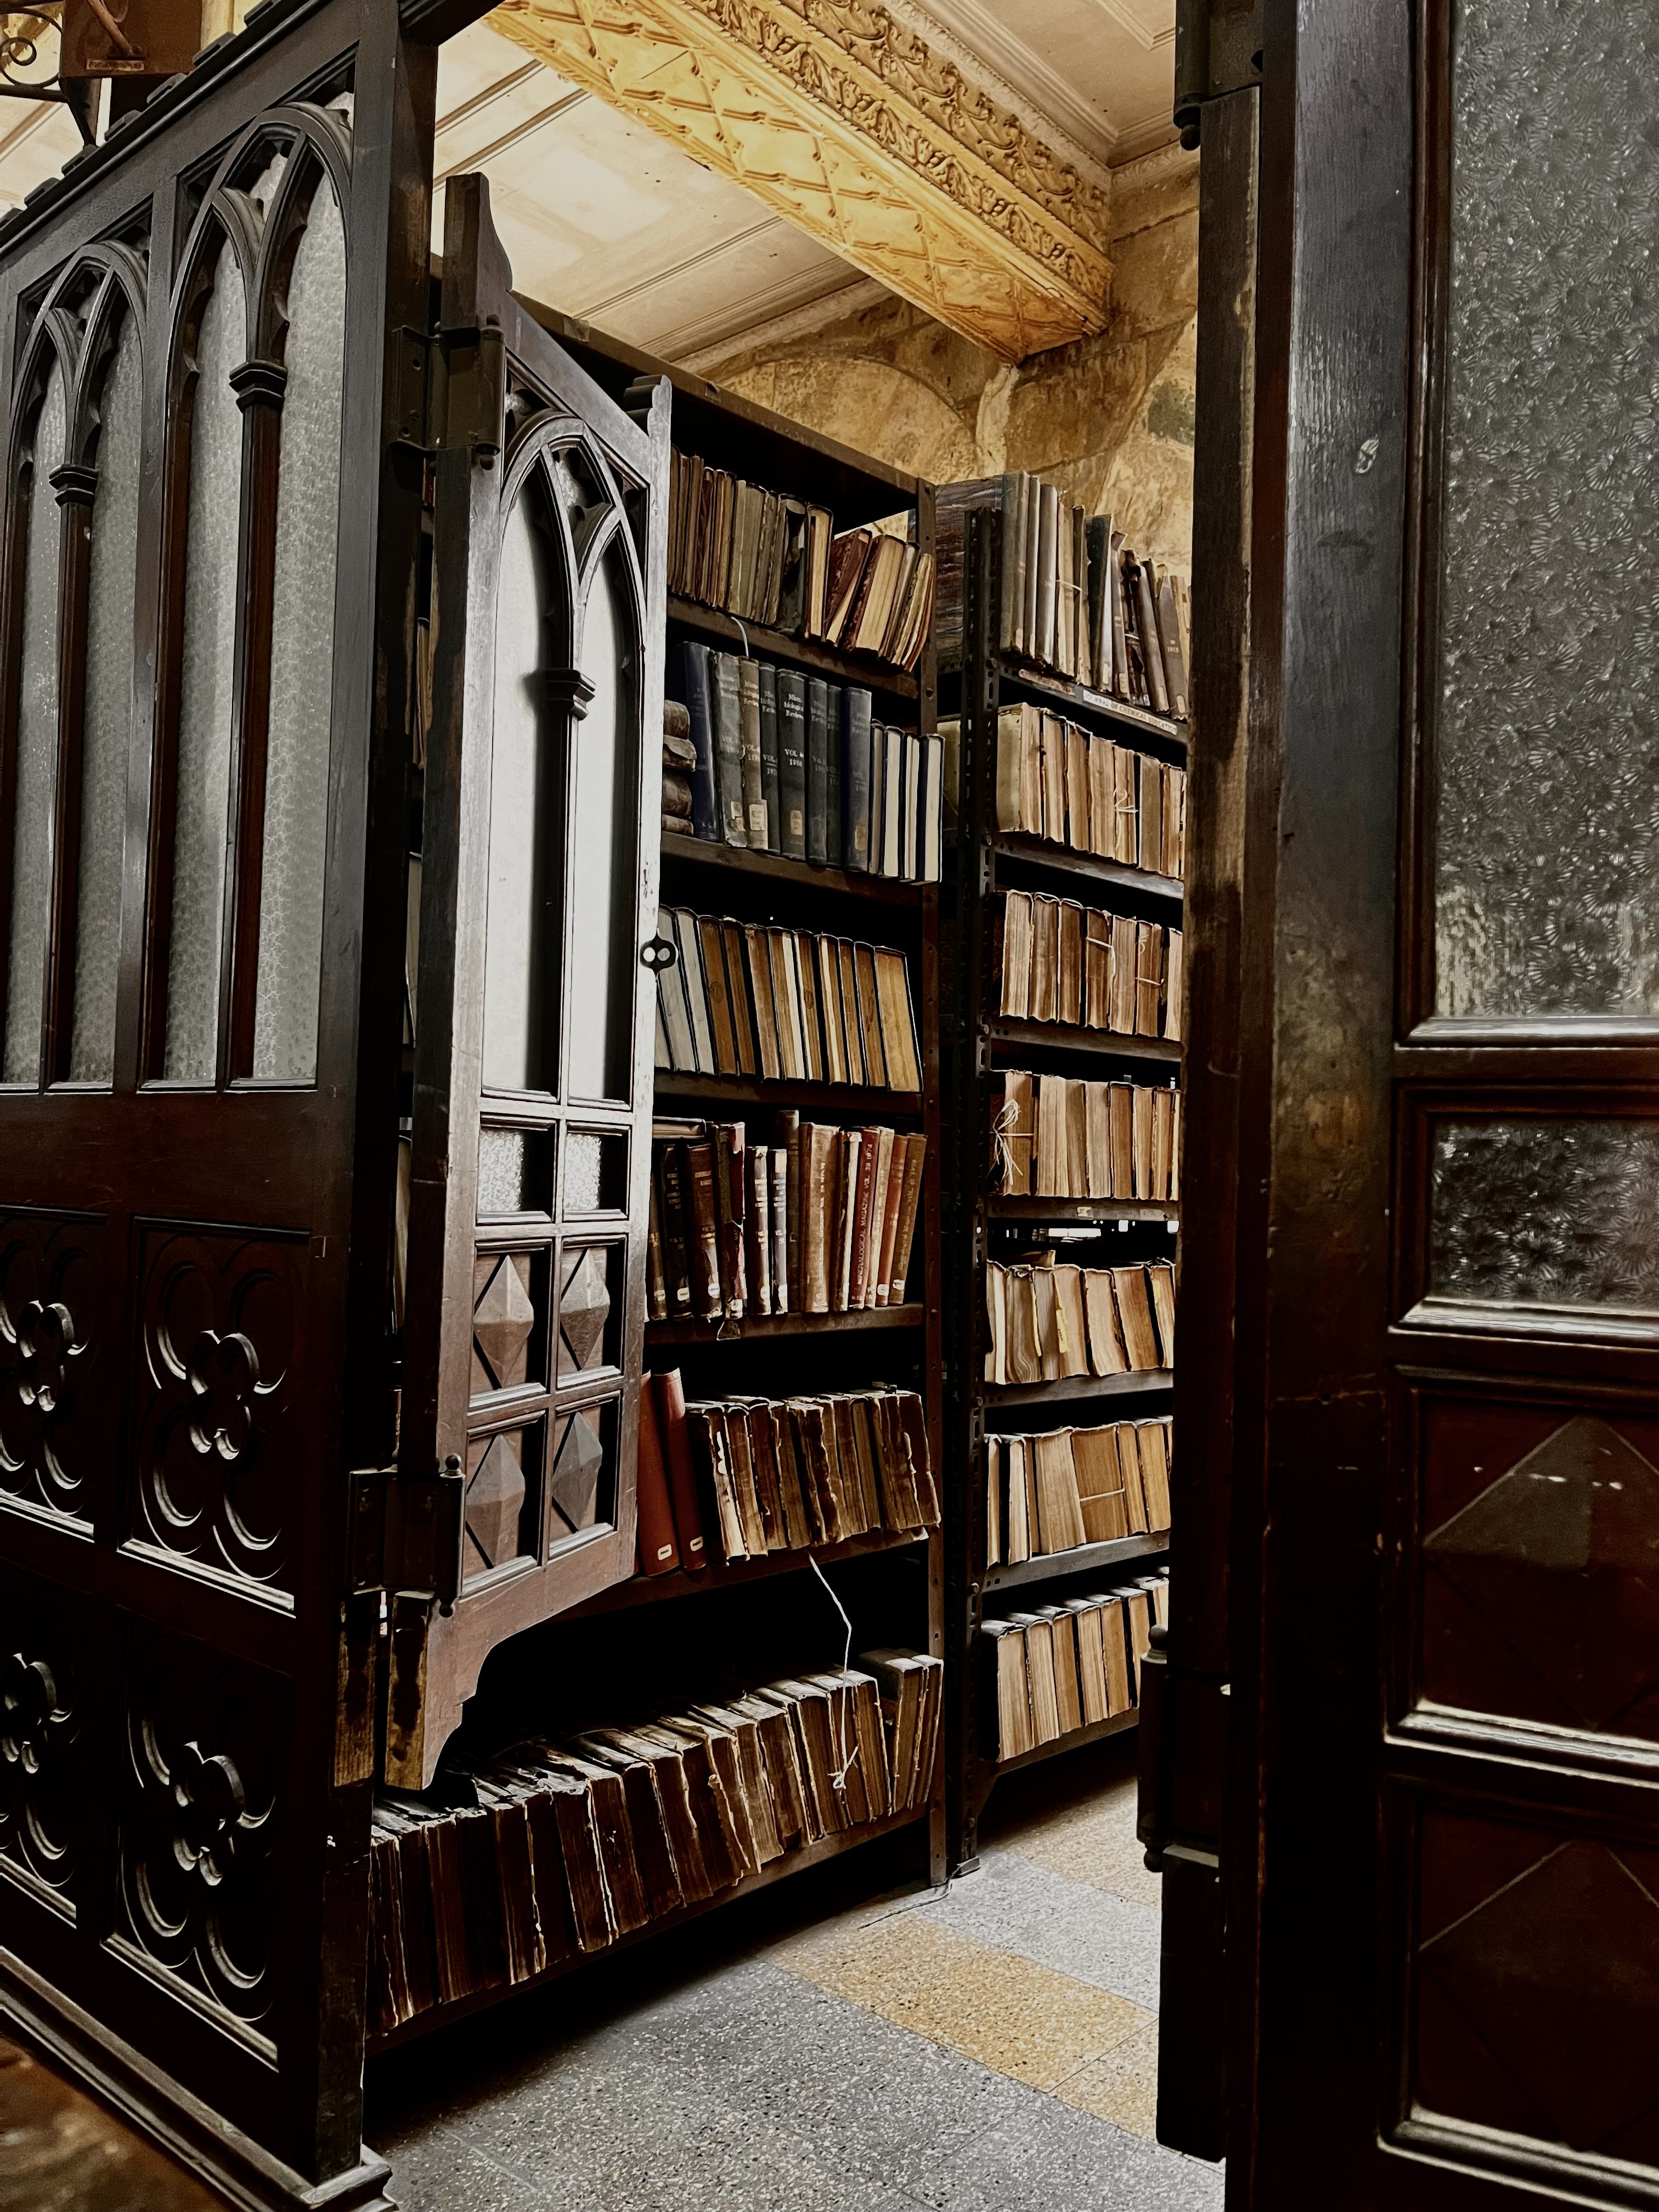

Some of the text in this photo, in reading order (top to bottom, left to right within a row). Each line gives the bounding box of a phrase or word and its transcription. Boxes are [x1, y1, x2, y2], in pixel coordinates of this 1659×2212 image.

[1111, 701, 1118, 710] OF
[1119, 706, 1147, 721] CHEMICAL
[785, 748, 798, 757] VOL
[860, 1191, 869, 1227] MAGAZINE
[857, 1228, 866, 1285] MINERALOGICAL
